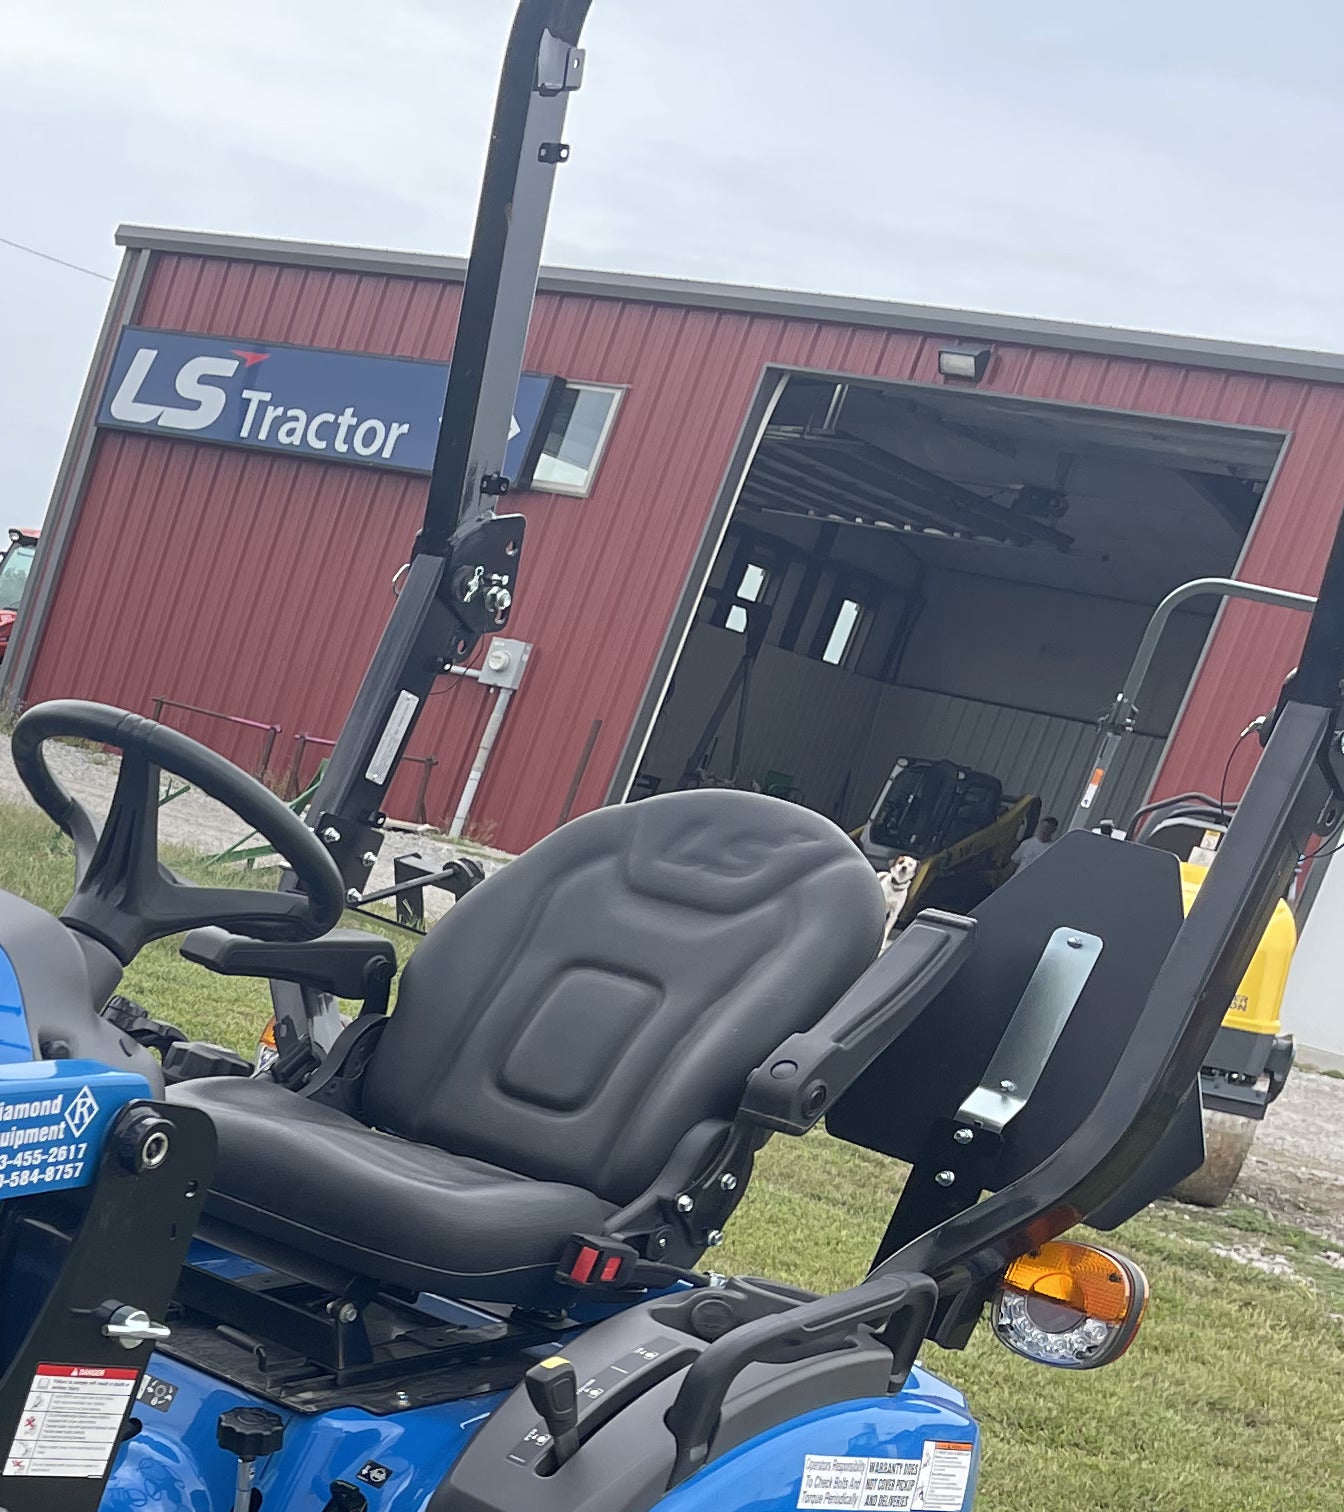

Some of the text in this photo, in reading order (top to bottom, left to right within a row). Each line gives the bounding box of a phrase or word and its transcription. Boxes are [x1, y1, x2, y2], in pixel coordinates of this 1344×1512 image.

[111, 347, 410, 459] LS Tractor
[72, 1097, 92, 1125] R
[869, 1461, 902, 1475] WARRANTY
[813, 1475, 832, 1489] Check
